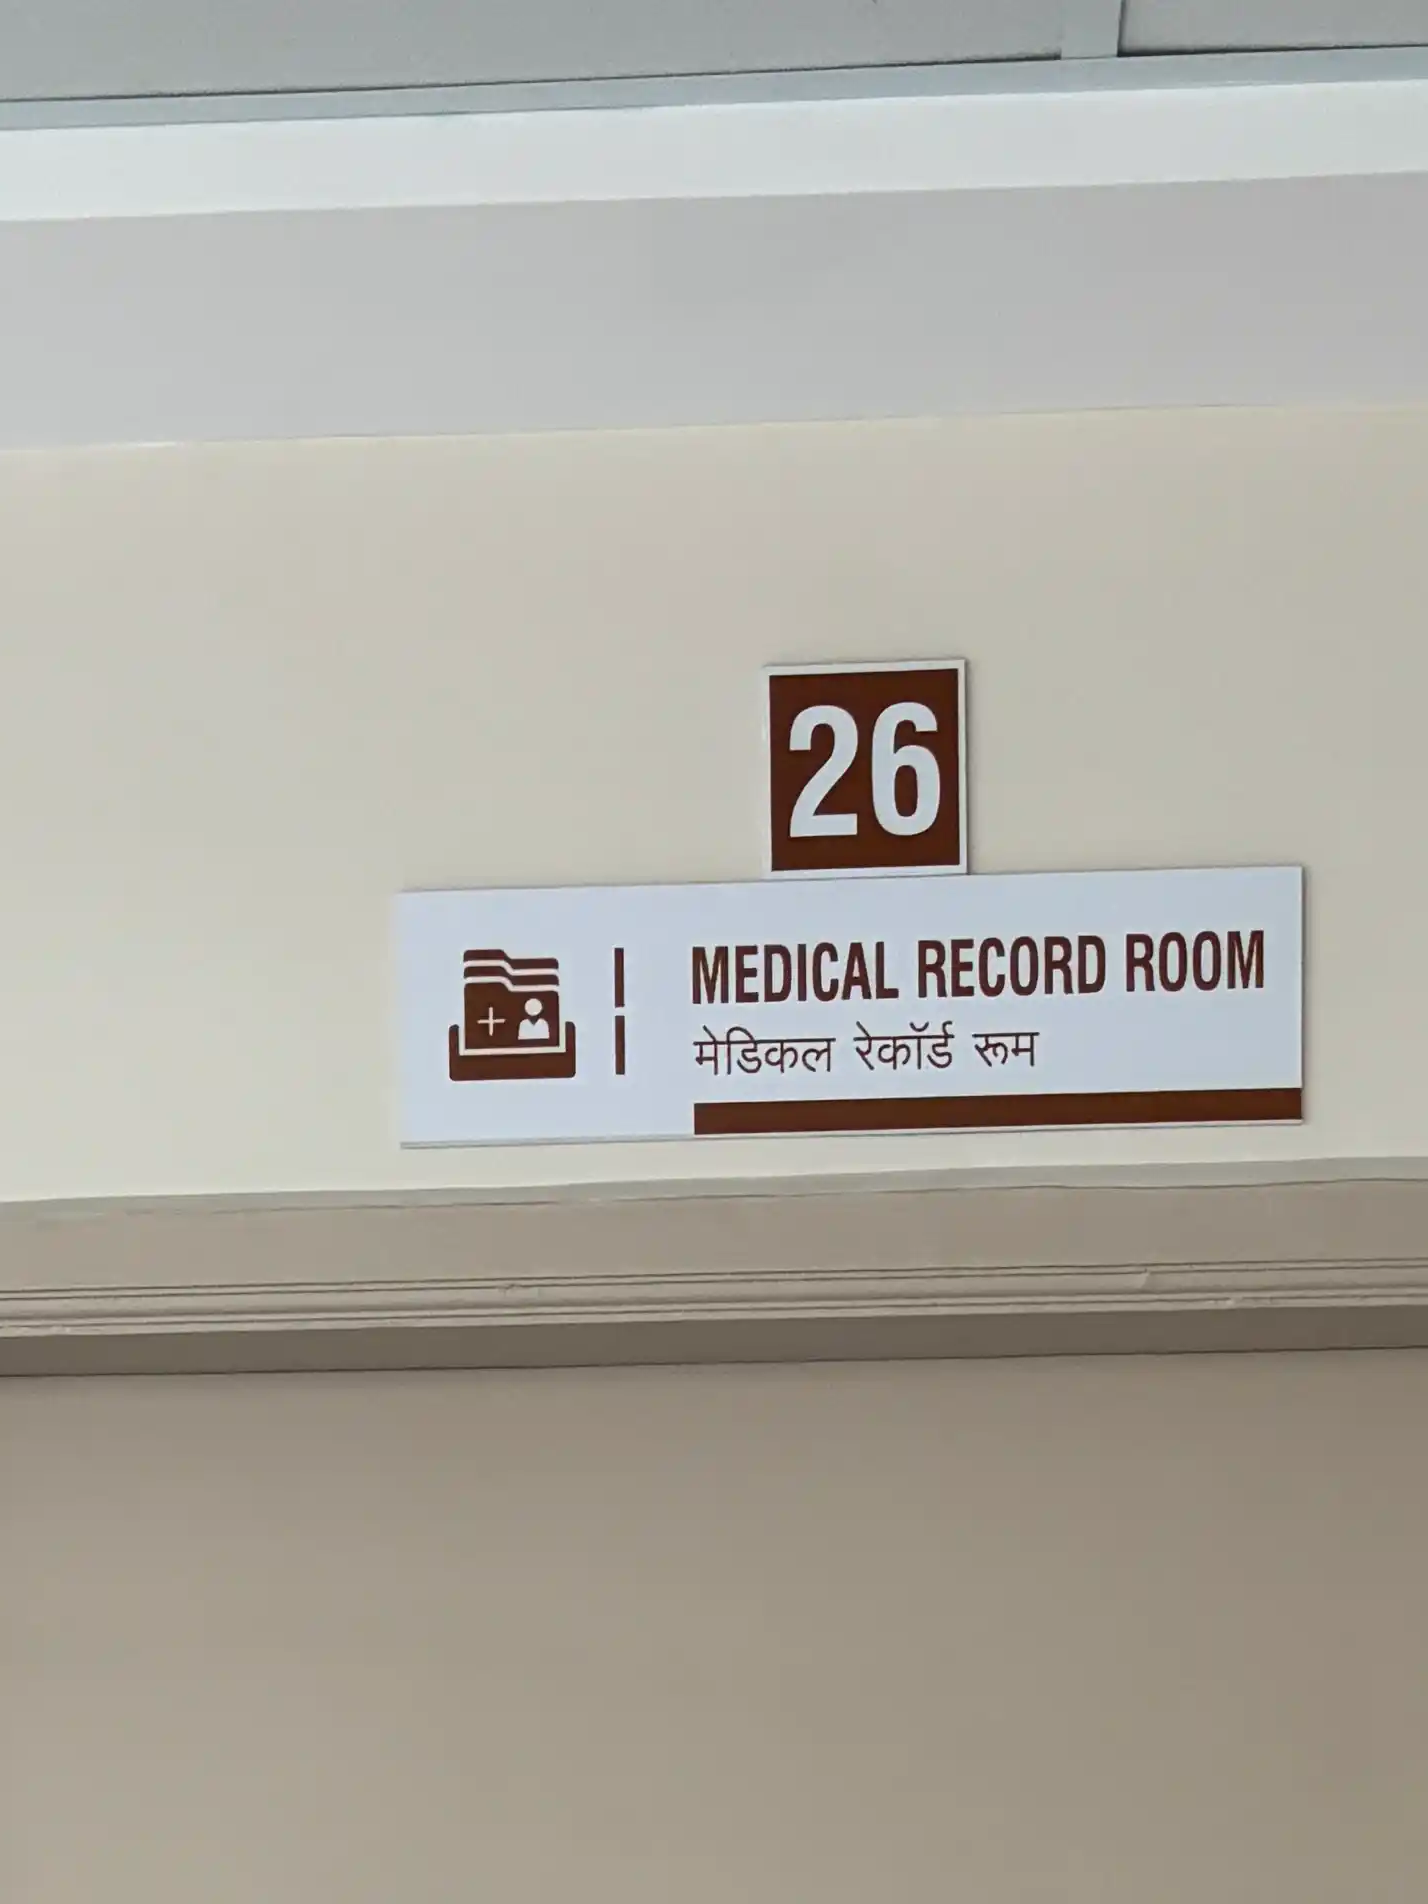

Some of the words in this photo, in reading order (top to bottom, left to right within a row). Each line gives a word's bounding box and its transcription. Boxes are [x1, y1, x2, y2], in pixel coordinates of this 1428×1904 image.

[789, 701, 941, 838] 26
[692, 941, 900, 1005] MEDICAL
[917, 935, 1106, 999] RECORD
[1125, 929, 1265, 993] ROOM
[692, 1024, 837, 1076] मेडिकल
[852, 1020, 955, 1071] रेकॉर्ड
[971, 1031, 1041, 1068] रूम
